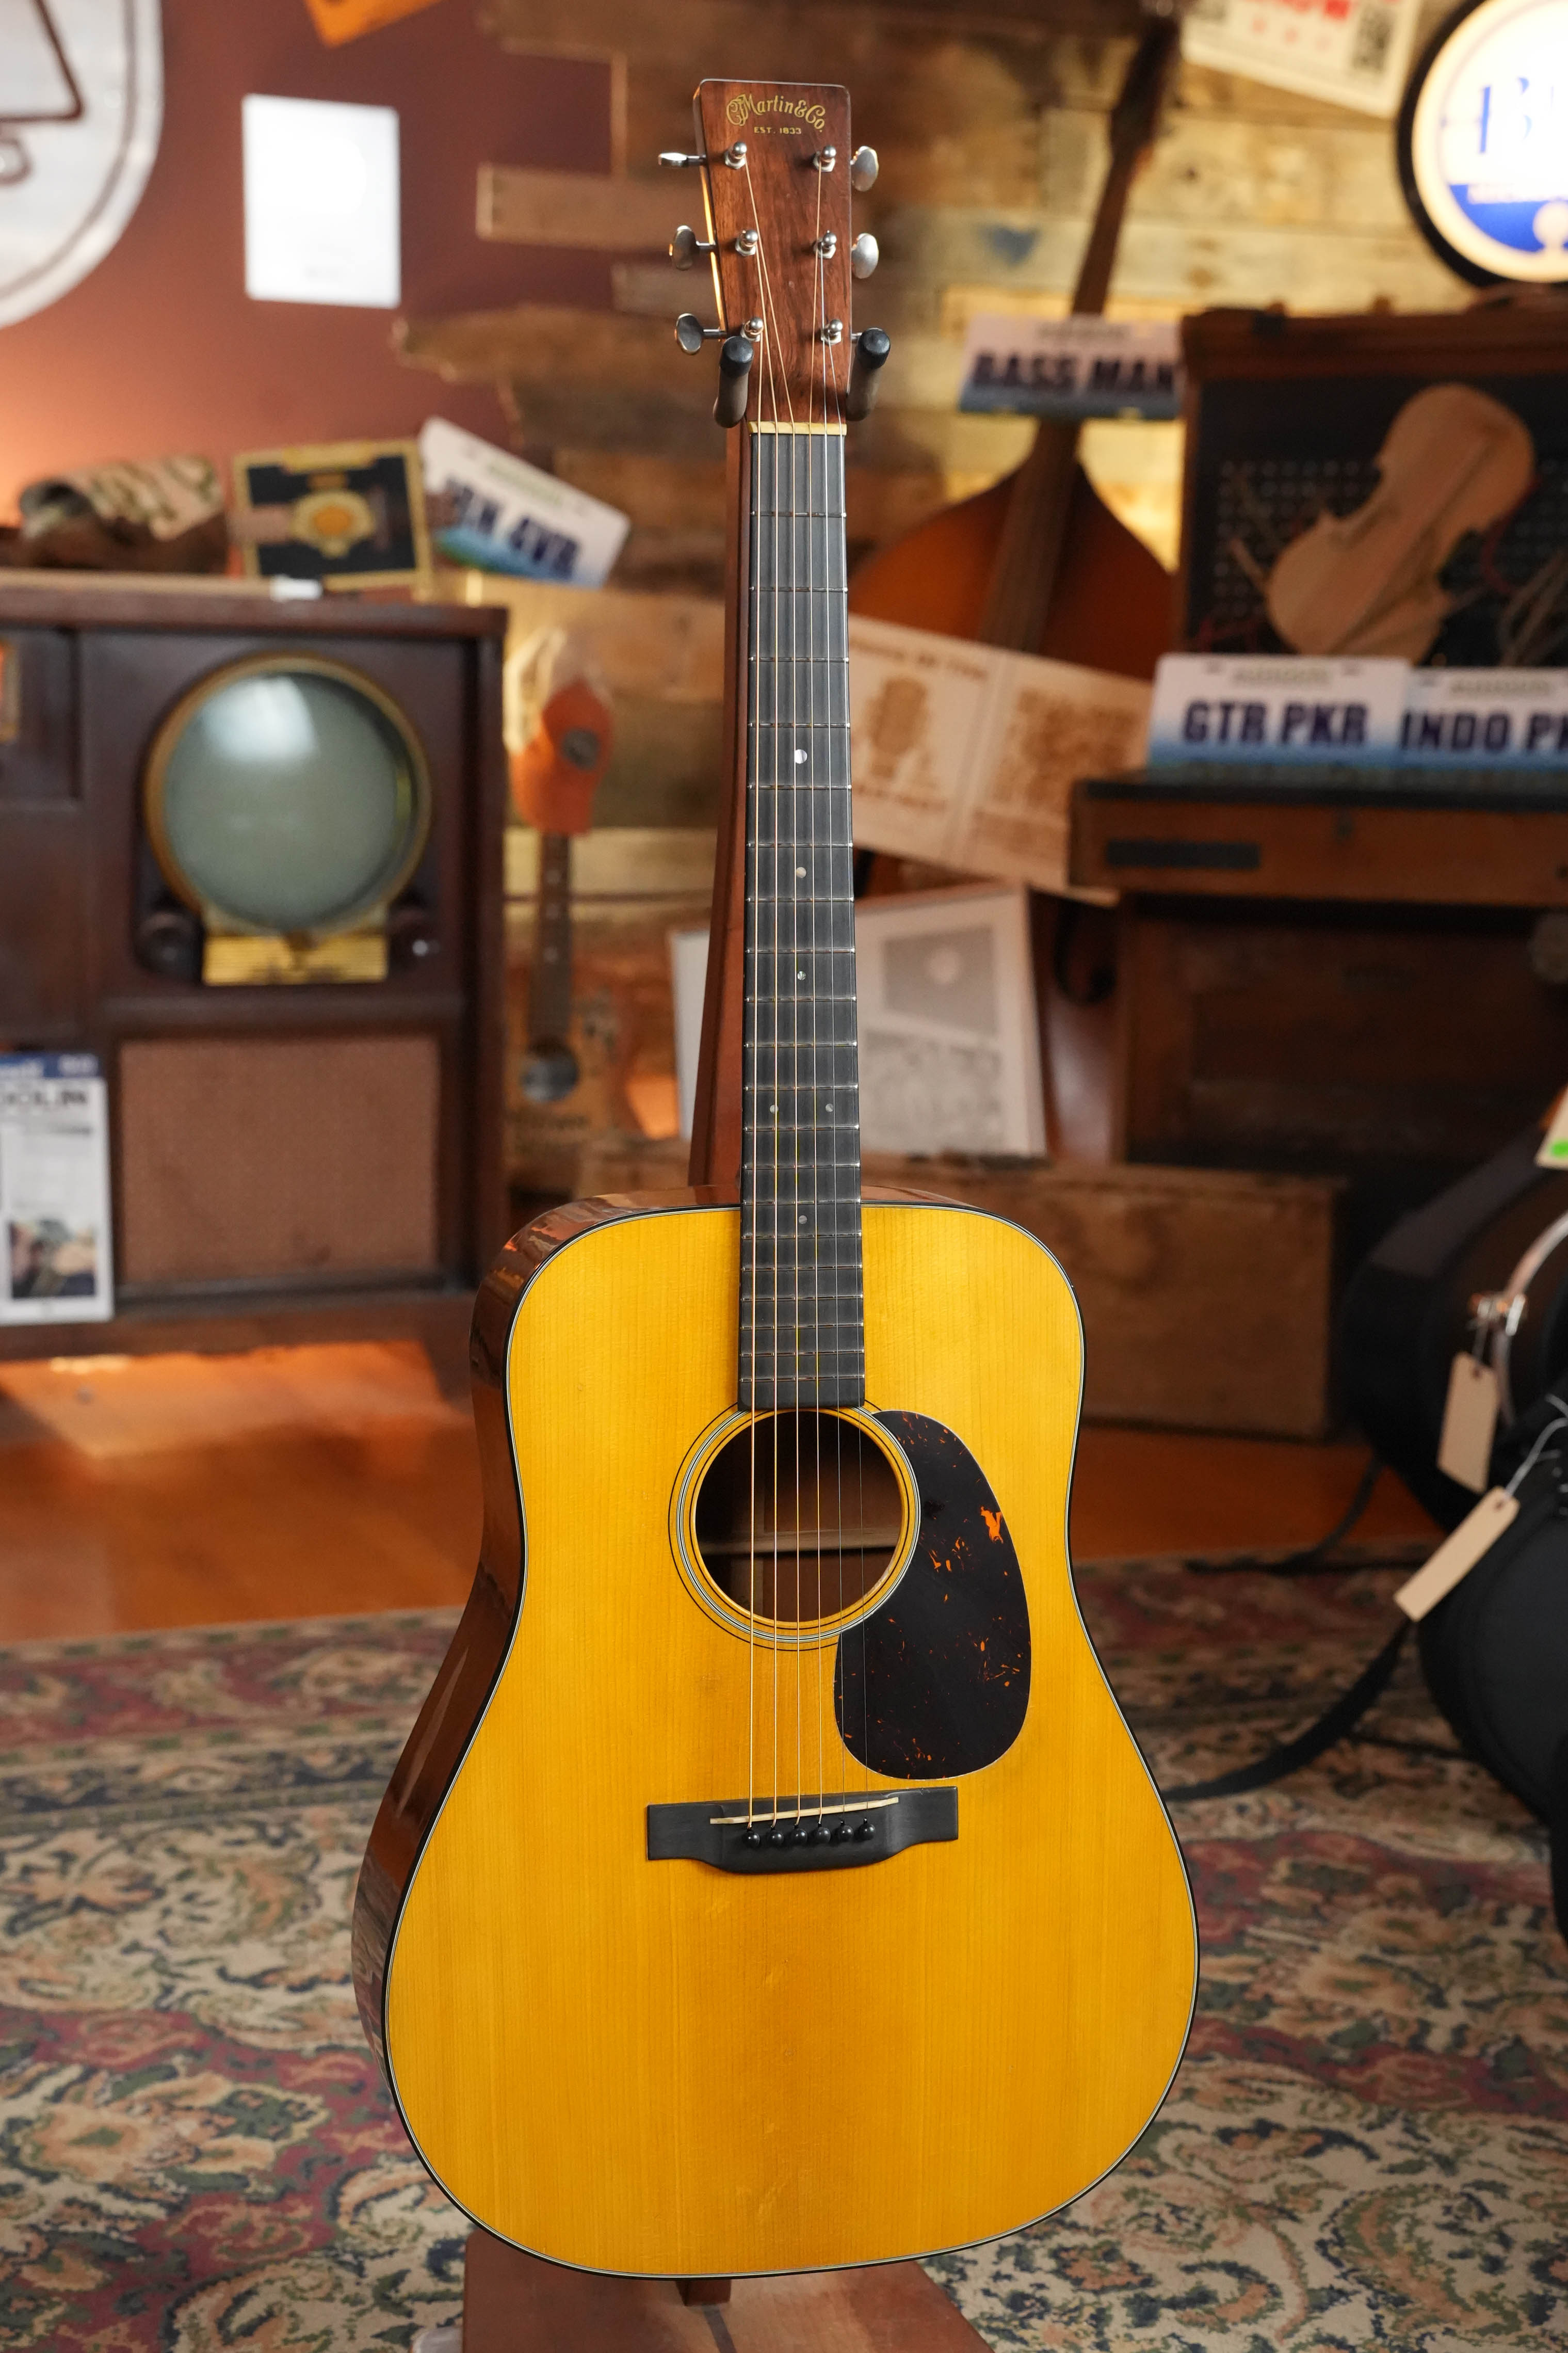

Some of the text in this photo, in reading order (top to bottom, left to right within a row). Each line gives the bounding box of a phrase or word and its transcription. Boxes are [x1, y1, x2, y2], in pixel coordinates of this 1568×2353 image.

[1183, 700, 1368, 745] GTR PKR
[1399, 709, 1512, 752] INDO
